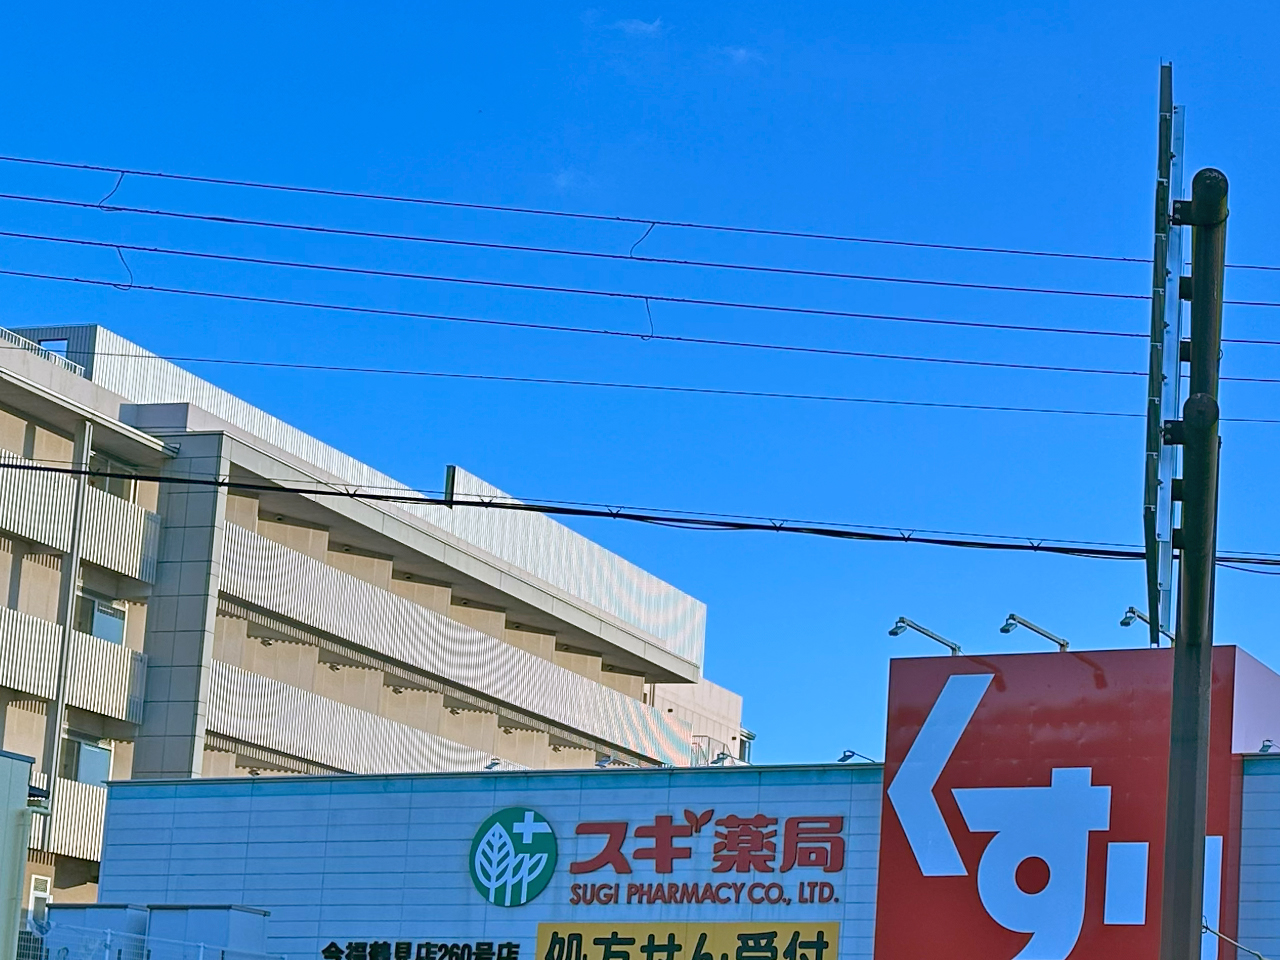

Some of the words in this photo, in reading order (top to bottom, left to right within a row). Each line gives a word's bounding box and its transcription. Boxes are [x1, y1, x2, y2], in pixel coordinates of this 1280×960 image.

[570, 809, 845, 874] スギ薬局
[570, 883, 619, 905] SUGI
[627, 883, 744, 904] PHARMACY
[747, 882, 791, 904] CO.,
[798, 881, 839, 903] LTD.
